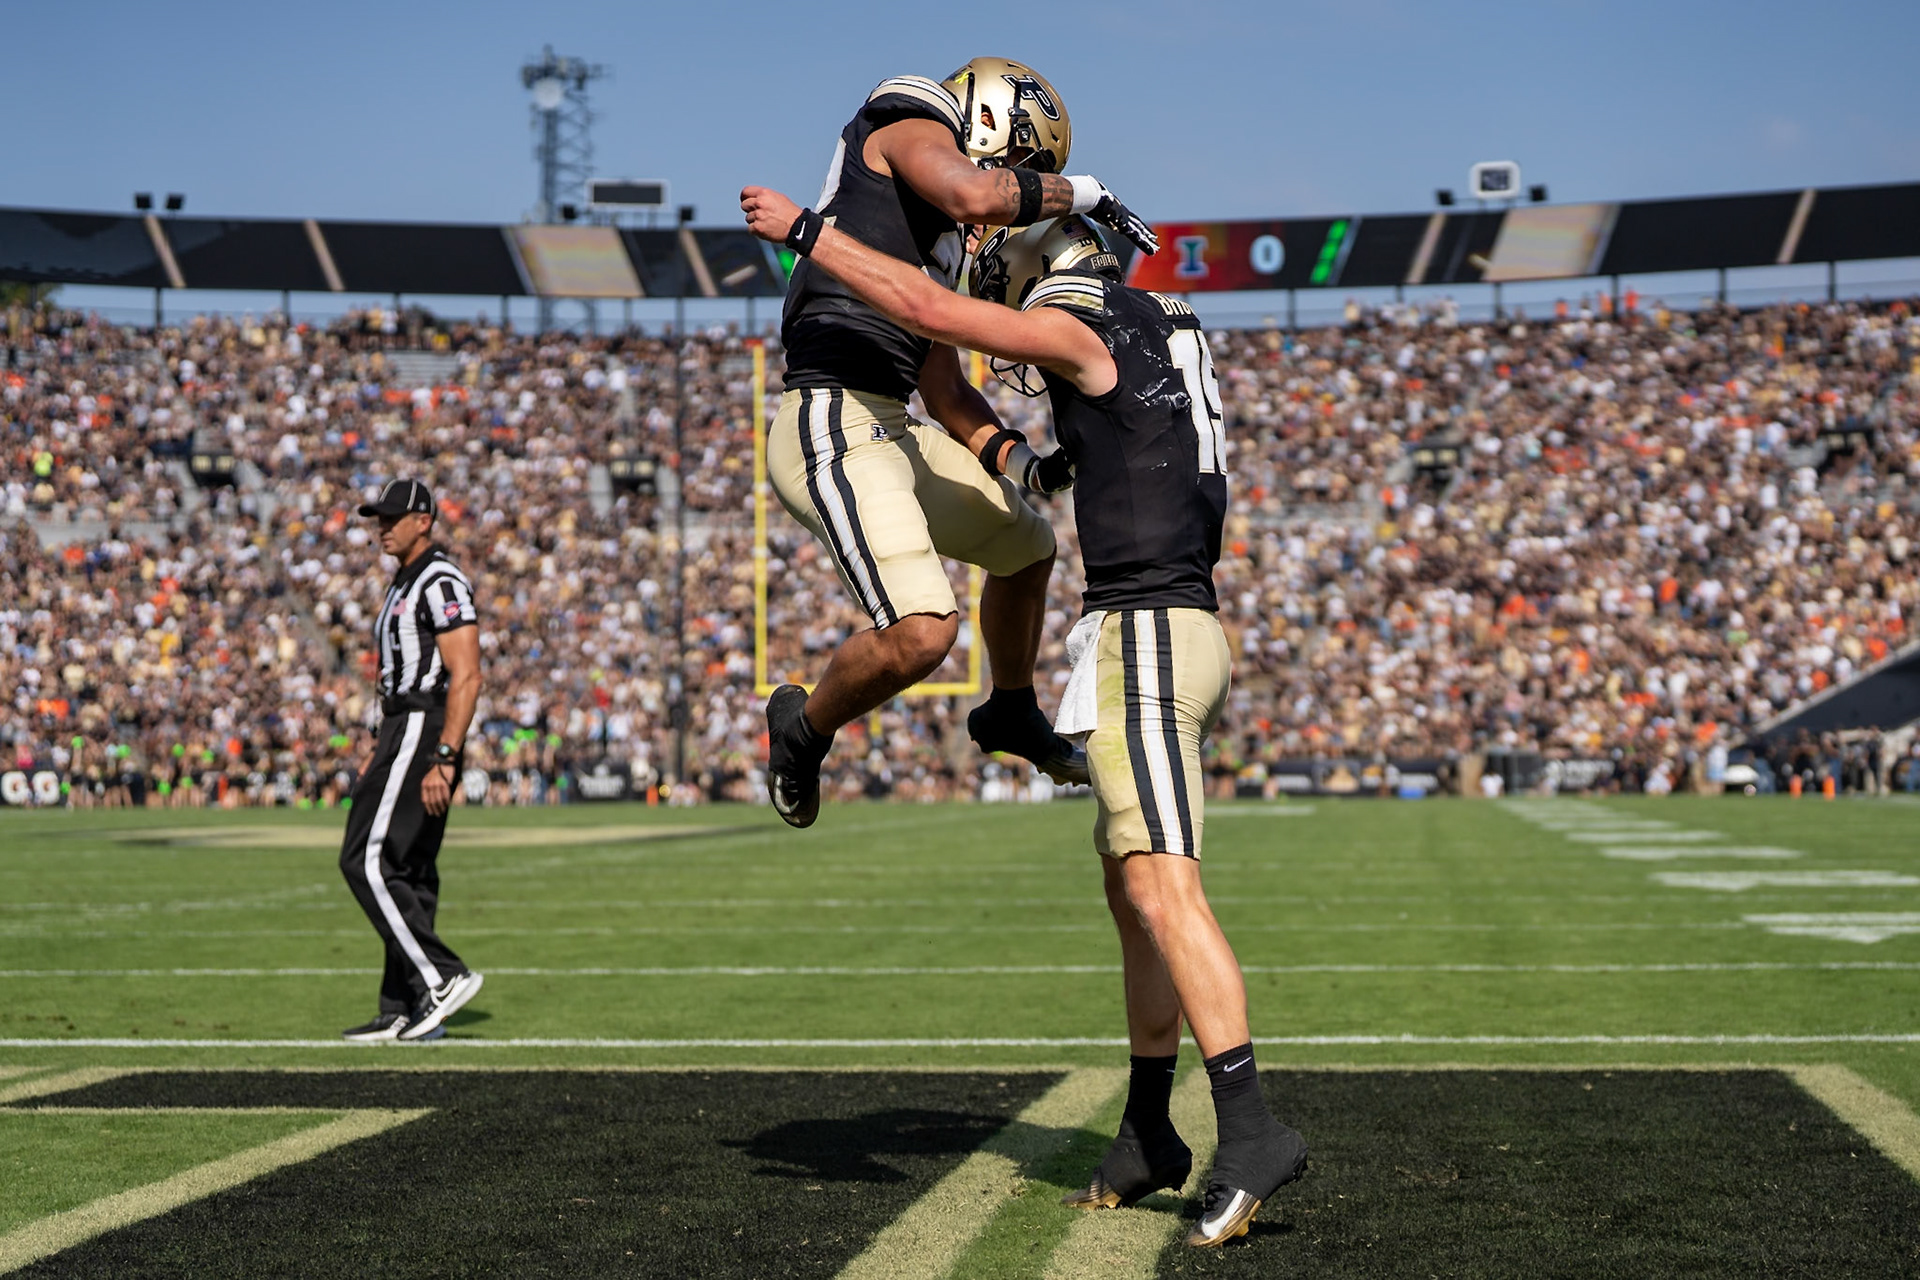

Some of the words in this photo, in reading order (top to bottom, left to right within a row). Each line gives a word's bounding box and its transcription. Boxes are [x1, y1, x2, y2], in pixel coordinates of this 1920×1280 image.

[1000, 73, 1060, 121] P
[1174, 235, 1209, 278] I
[1250, 234, 1285, 275] 0
[870, 423, 888, 441] P
